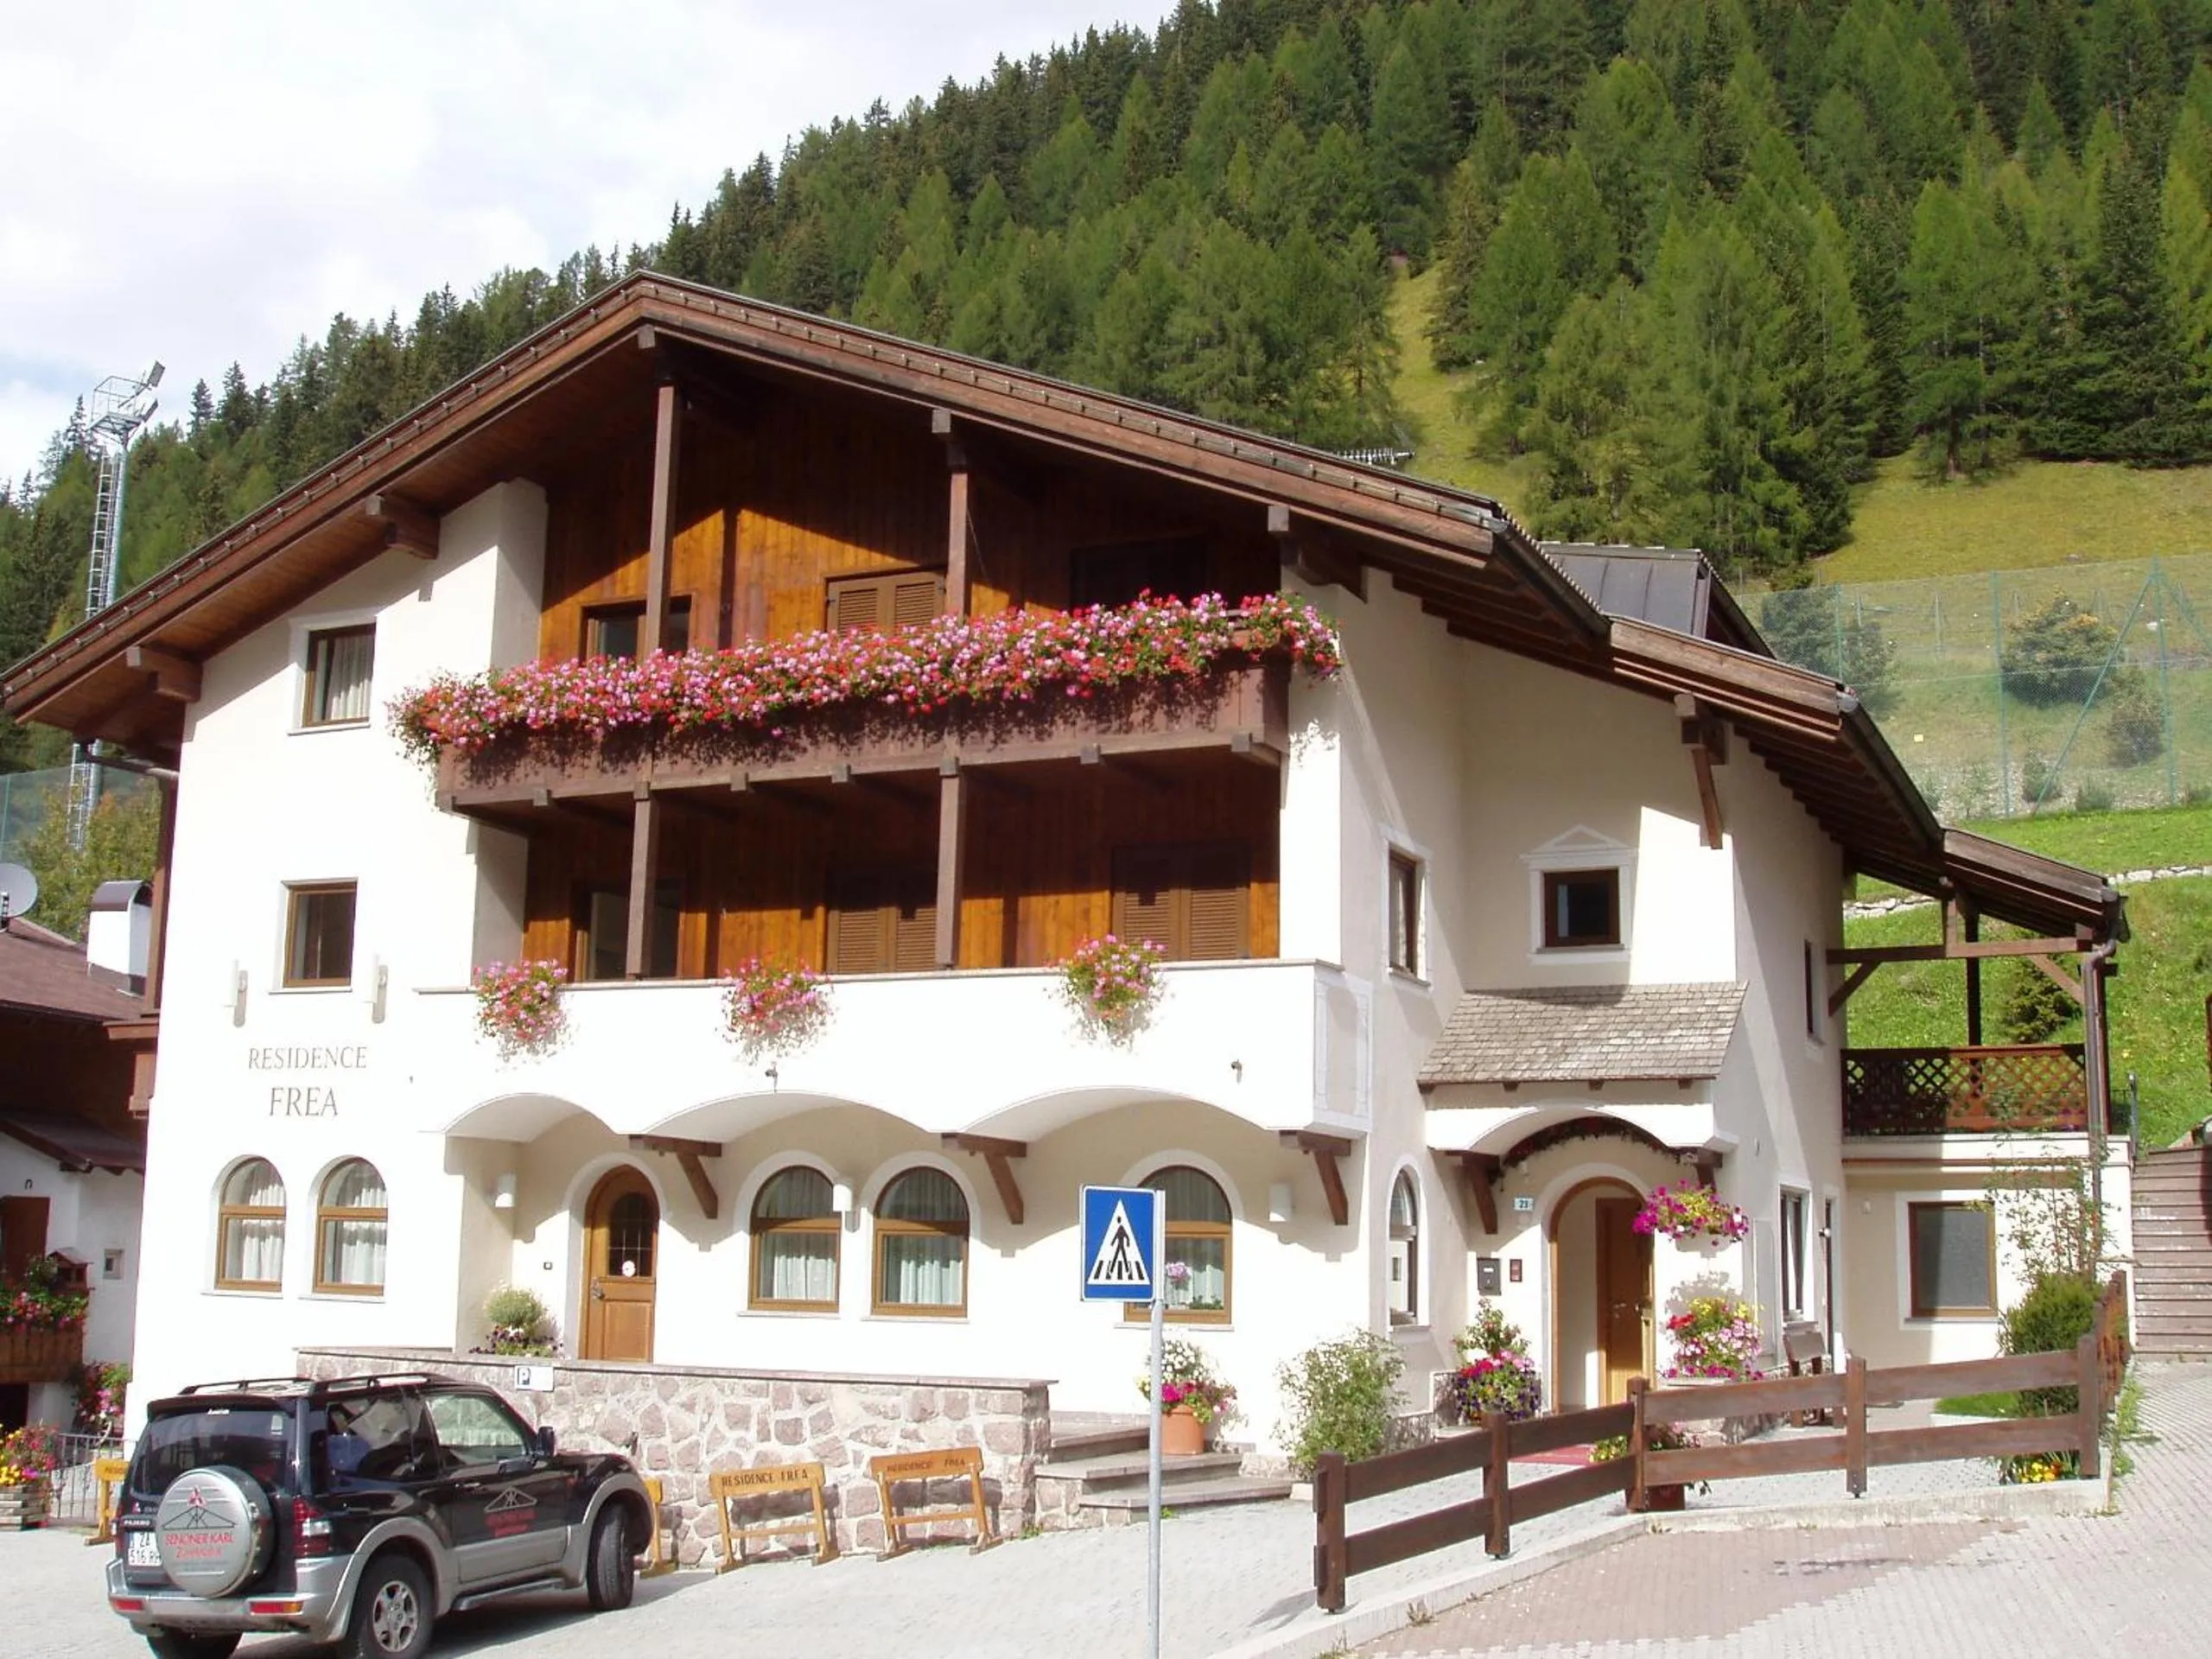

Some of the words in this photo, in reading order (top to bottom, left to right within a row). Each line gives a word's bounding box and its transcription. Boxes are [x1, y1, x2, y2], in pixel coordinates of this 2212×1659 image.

[248, 1046, 367, 1070] RESIDENCE
[269, 1087, 339, 1116] FREA
[517, 1368, 531, 1385] P
[721, 1472, 776, 1487] RESIDENCE
[780, 1468, 809, 1481] FREA
